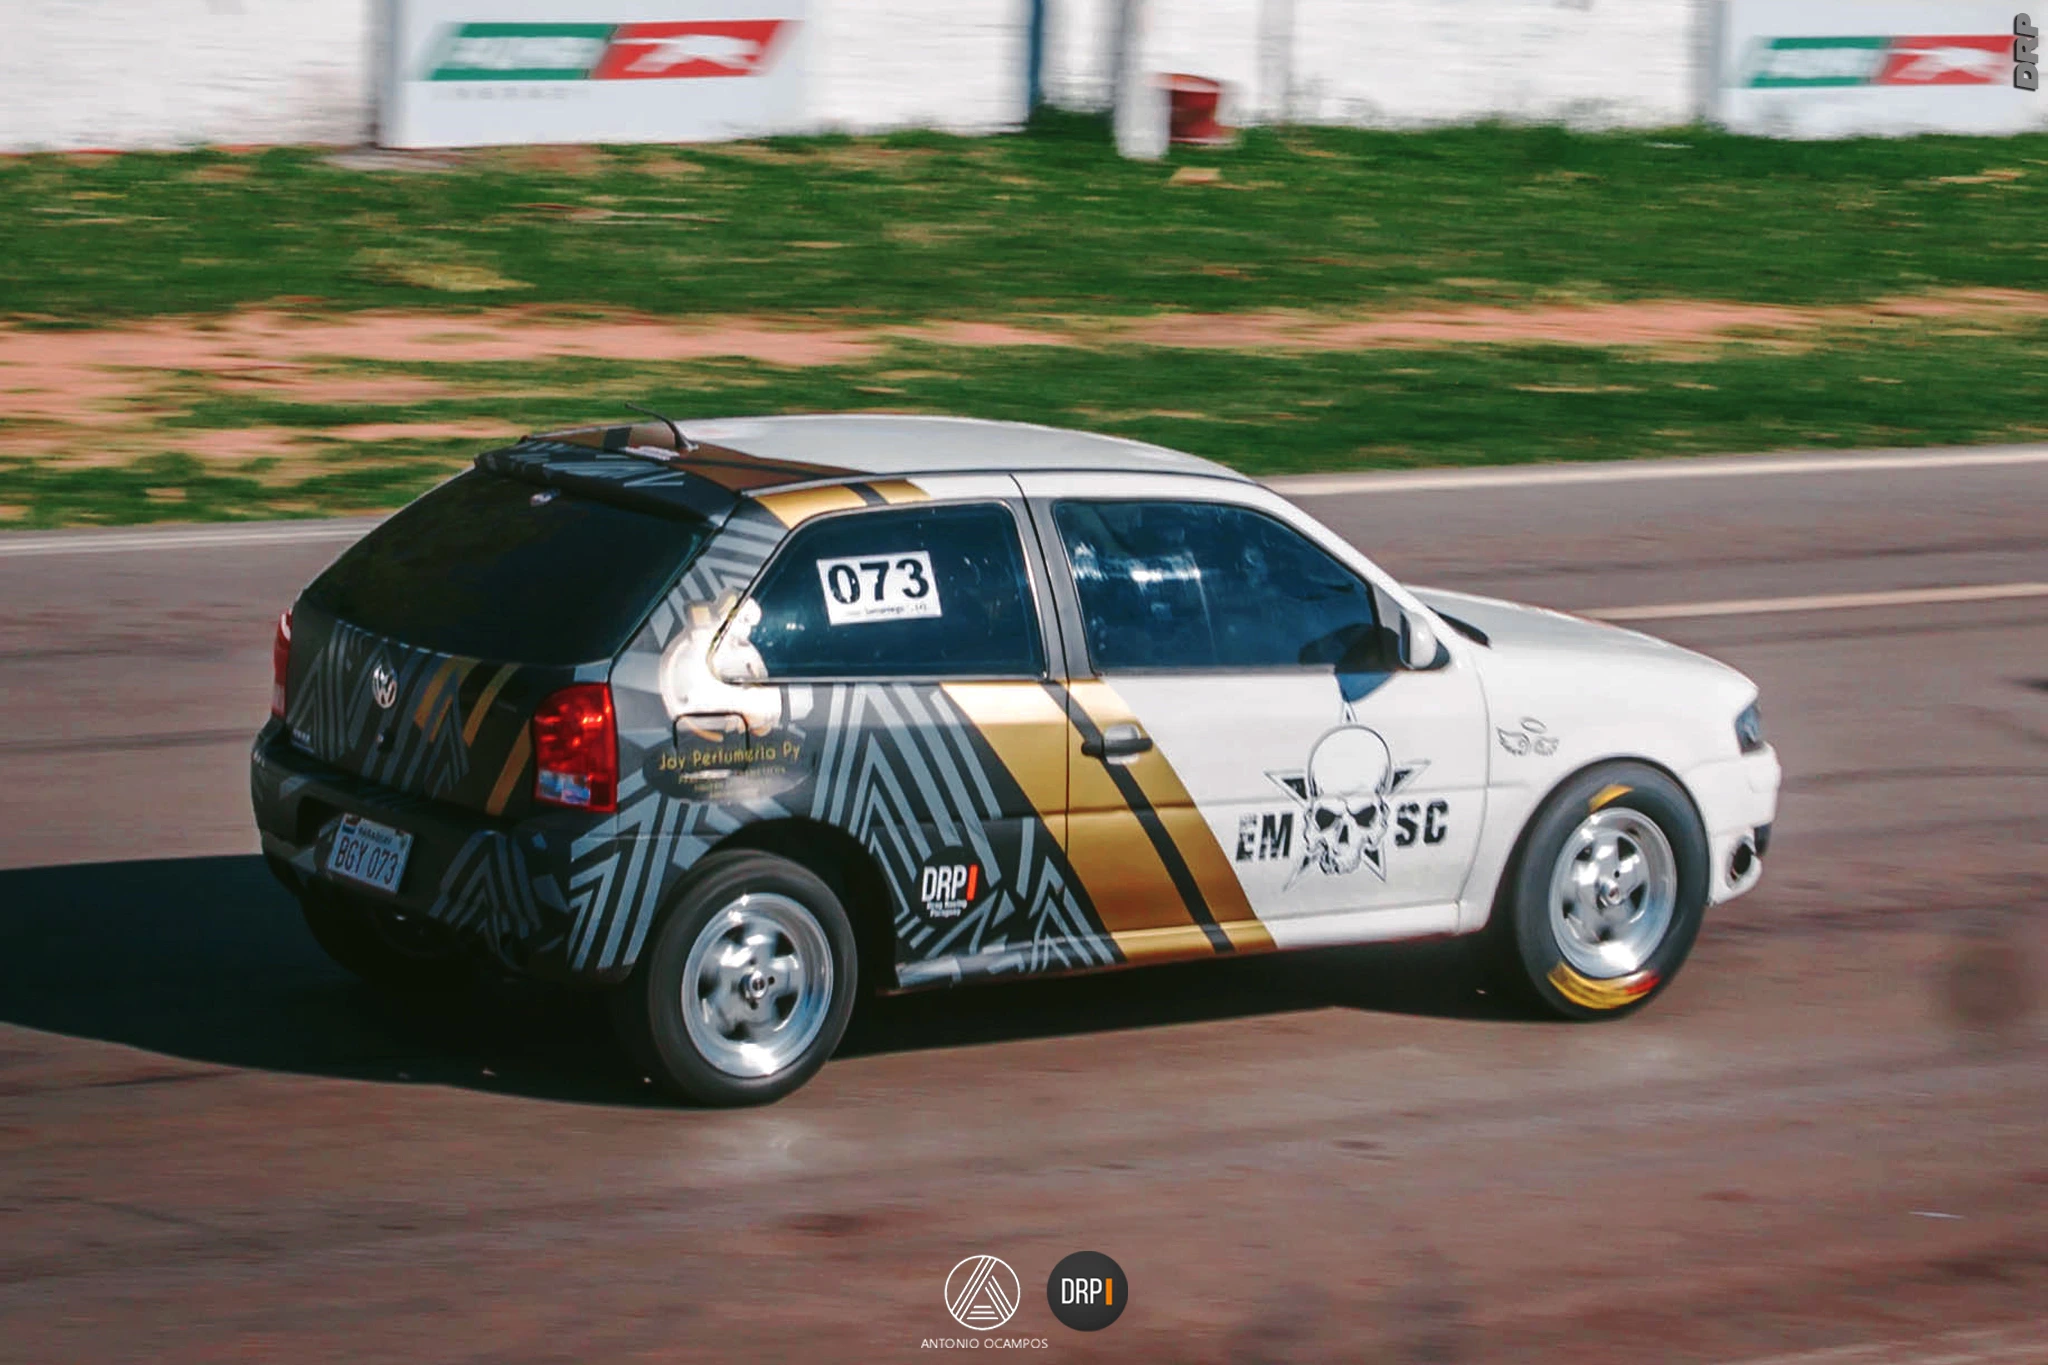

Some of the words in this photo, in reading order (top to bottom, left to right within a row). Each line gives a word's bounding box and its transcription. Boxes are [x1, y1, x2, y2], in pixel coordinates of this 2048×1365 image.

[828, 558, 930, 604] 073
[1235, 811, 1294, 863] EM
[1394, 799, 1450, 847] SC
[334, 835, 368, 874] BGY
[366, 846, 399, 885] 073
